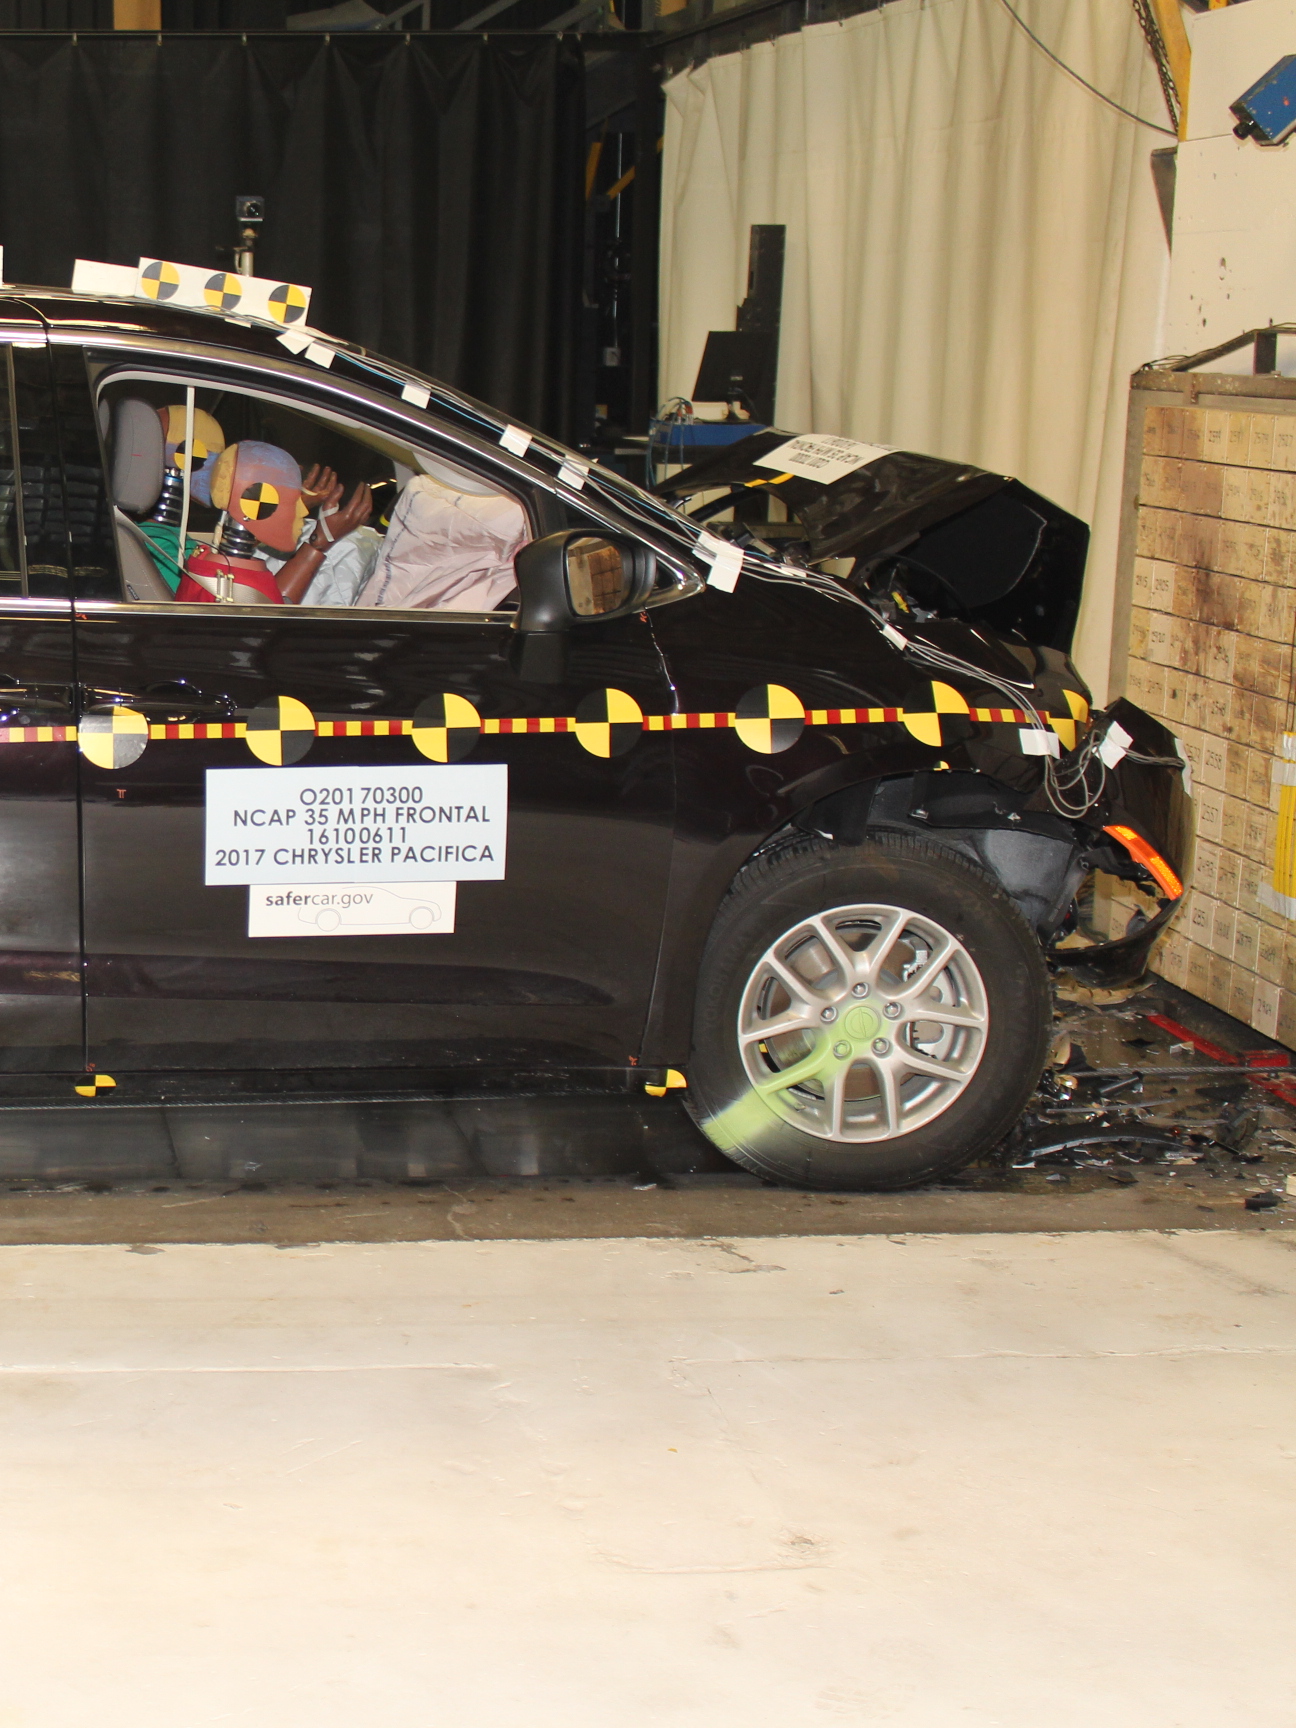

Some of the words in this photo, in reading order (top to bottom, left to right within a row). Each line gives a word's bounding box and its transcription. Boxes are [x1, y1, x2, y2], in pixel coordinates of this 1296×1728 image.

[233, 808, 297, 827] NCAP
[304, 808, 329, 825] 35
[337, 807, 386, 825] MPH
[395, 805, 491, 824] FRONTAL
[307, 827, 406, 846] 16100611
[215, 848, 266, 867] 2017
[273, 846, 382, 866] CHRYSLER
[390, 844, 494, 863] PACIFICA
[265, 891, 374, 909] safercar.gov
